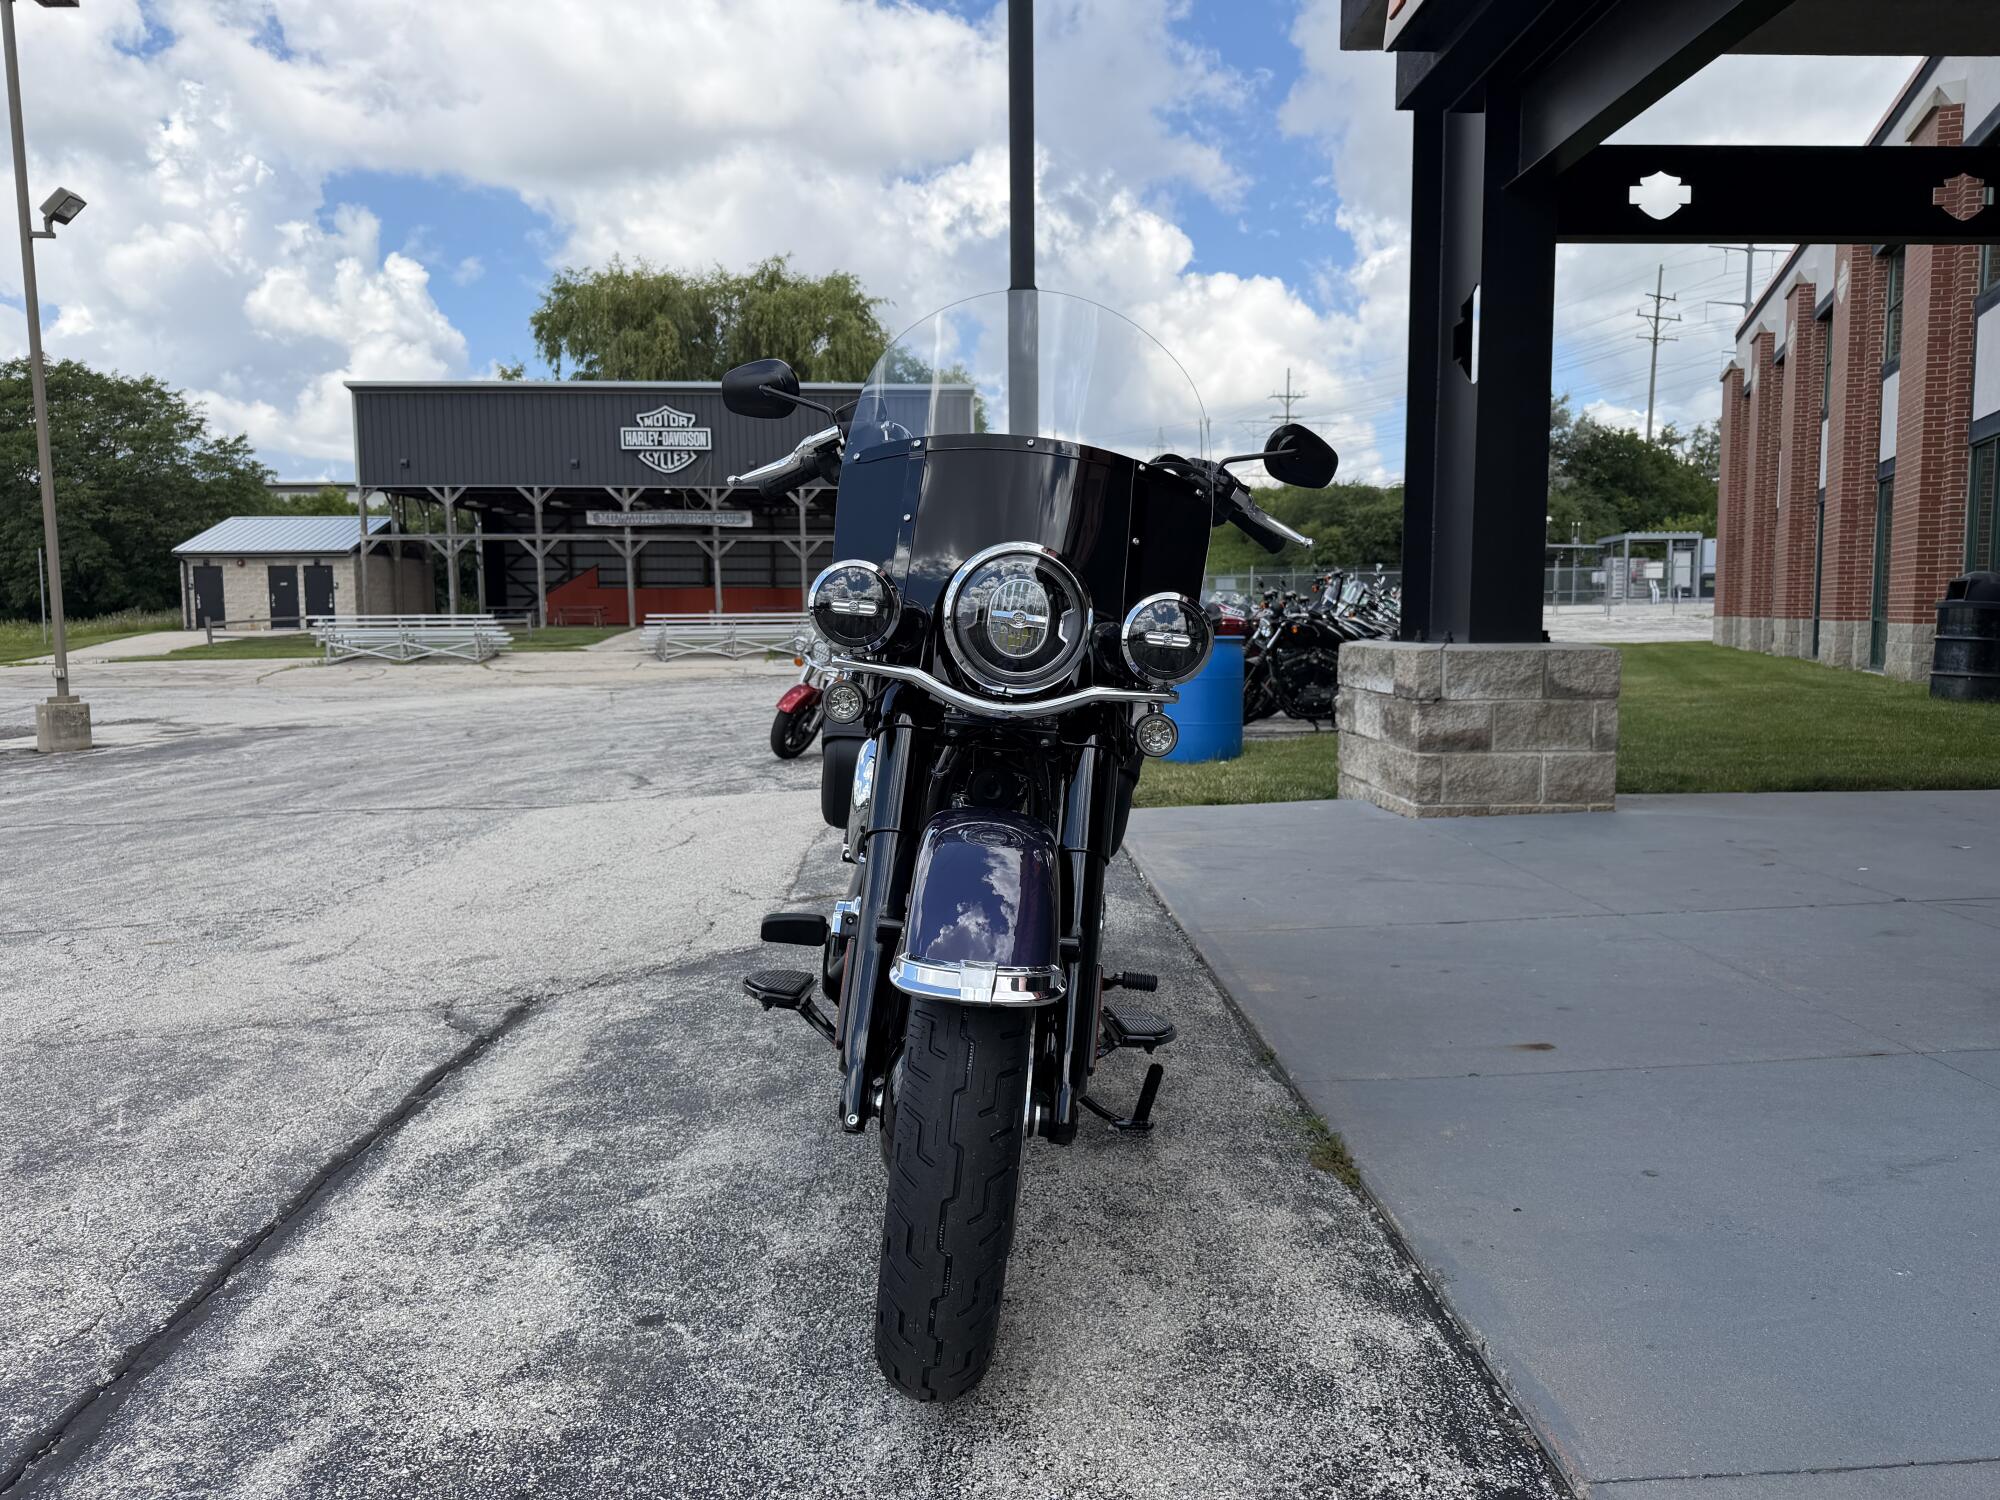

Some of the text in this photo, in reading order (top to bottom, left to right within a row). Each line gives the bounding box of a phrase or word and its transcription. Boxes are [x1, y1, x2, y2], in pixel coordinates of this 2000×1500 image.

[643, 409, 688, 427] MOTOR
[624, 431, 707, 446] HARLEY-DAVIDSON
[645, 451, 689, 469] CYCLES
